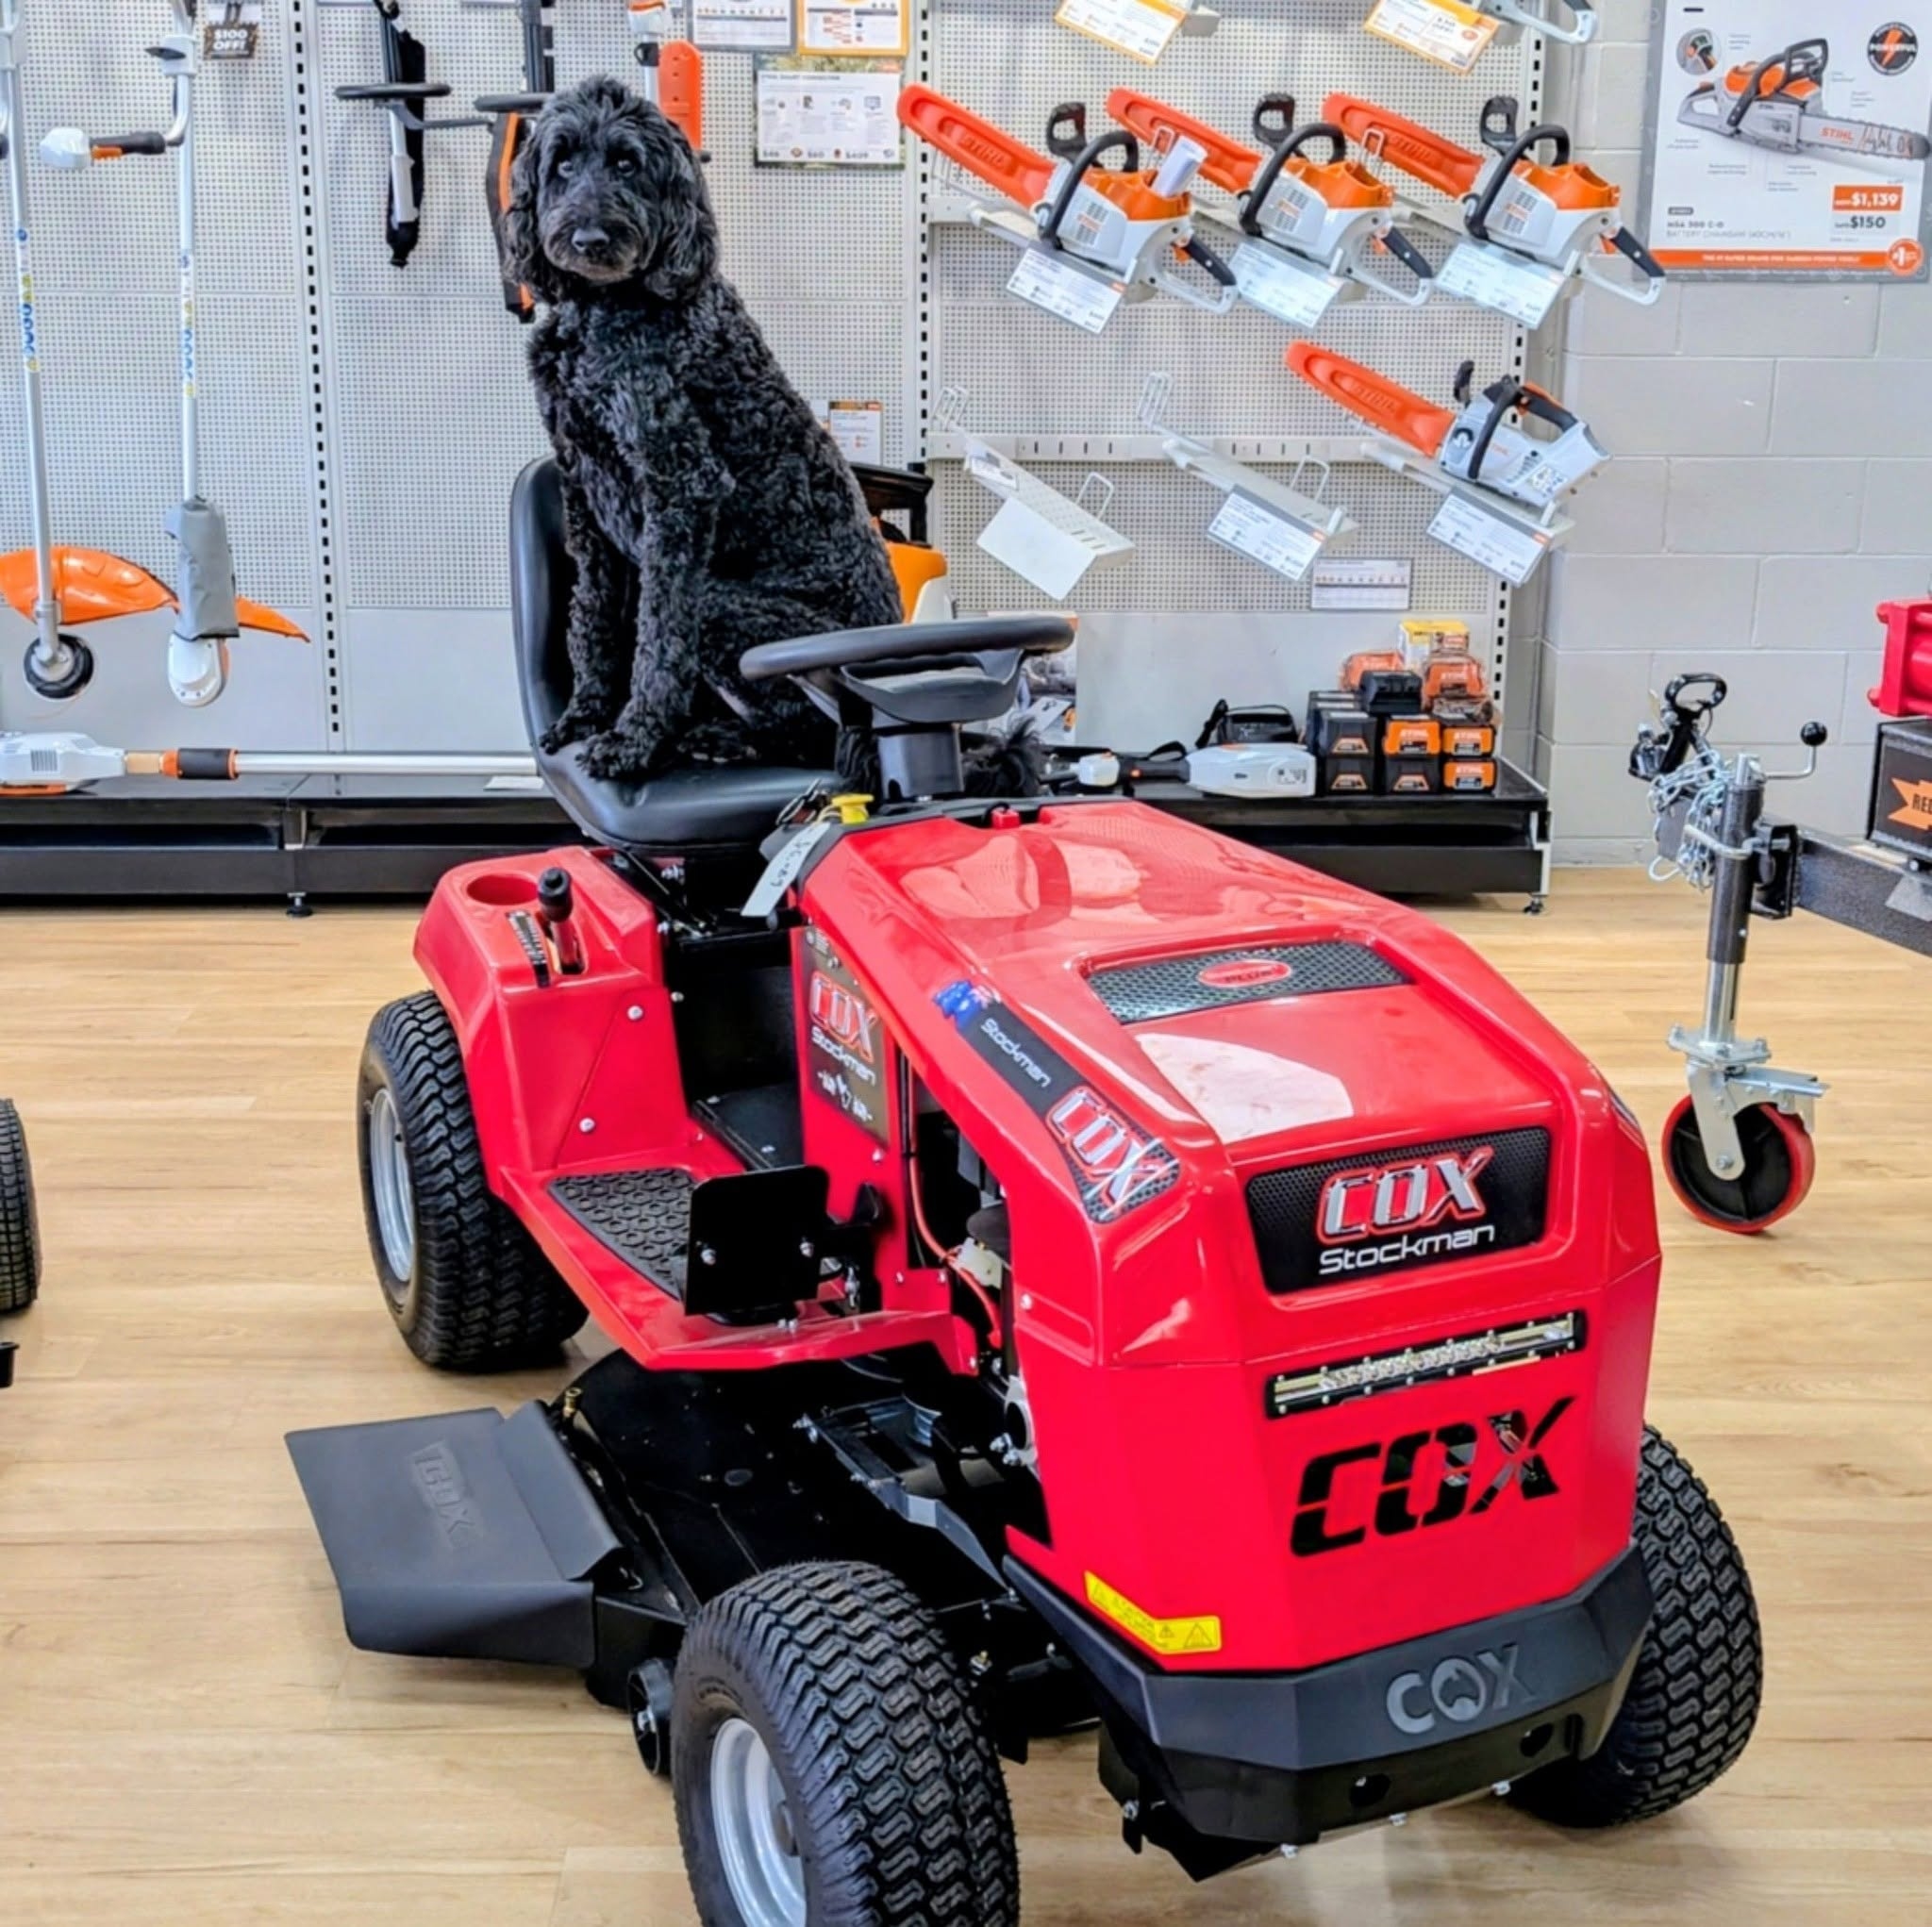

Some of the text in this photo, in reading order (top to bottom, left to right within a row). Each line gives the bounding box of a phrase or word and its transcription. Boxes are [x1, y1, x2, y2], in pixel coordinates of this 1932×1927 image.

[213, 29, 248, 40] $100
[1822, 126, 1854, 141] STIHL
[1851, 216, 1886, 229] $150
[1852, 192, 1898, 207] $1,139
[809, 971, 877, 1063] COX
[812, 1025, 875, 1086] Stockman
[981, 1018, 1052, 1088] Stockman
[1045, 1086, 1167, 1208] COX
[1318, 1146, 1494, 1244] COX
[1319, 1224, 1495, 1275] Stockman
[1290, 1396, 1577, 1557] COX
[1386, 1644, 1532, 1735] COX
